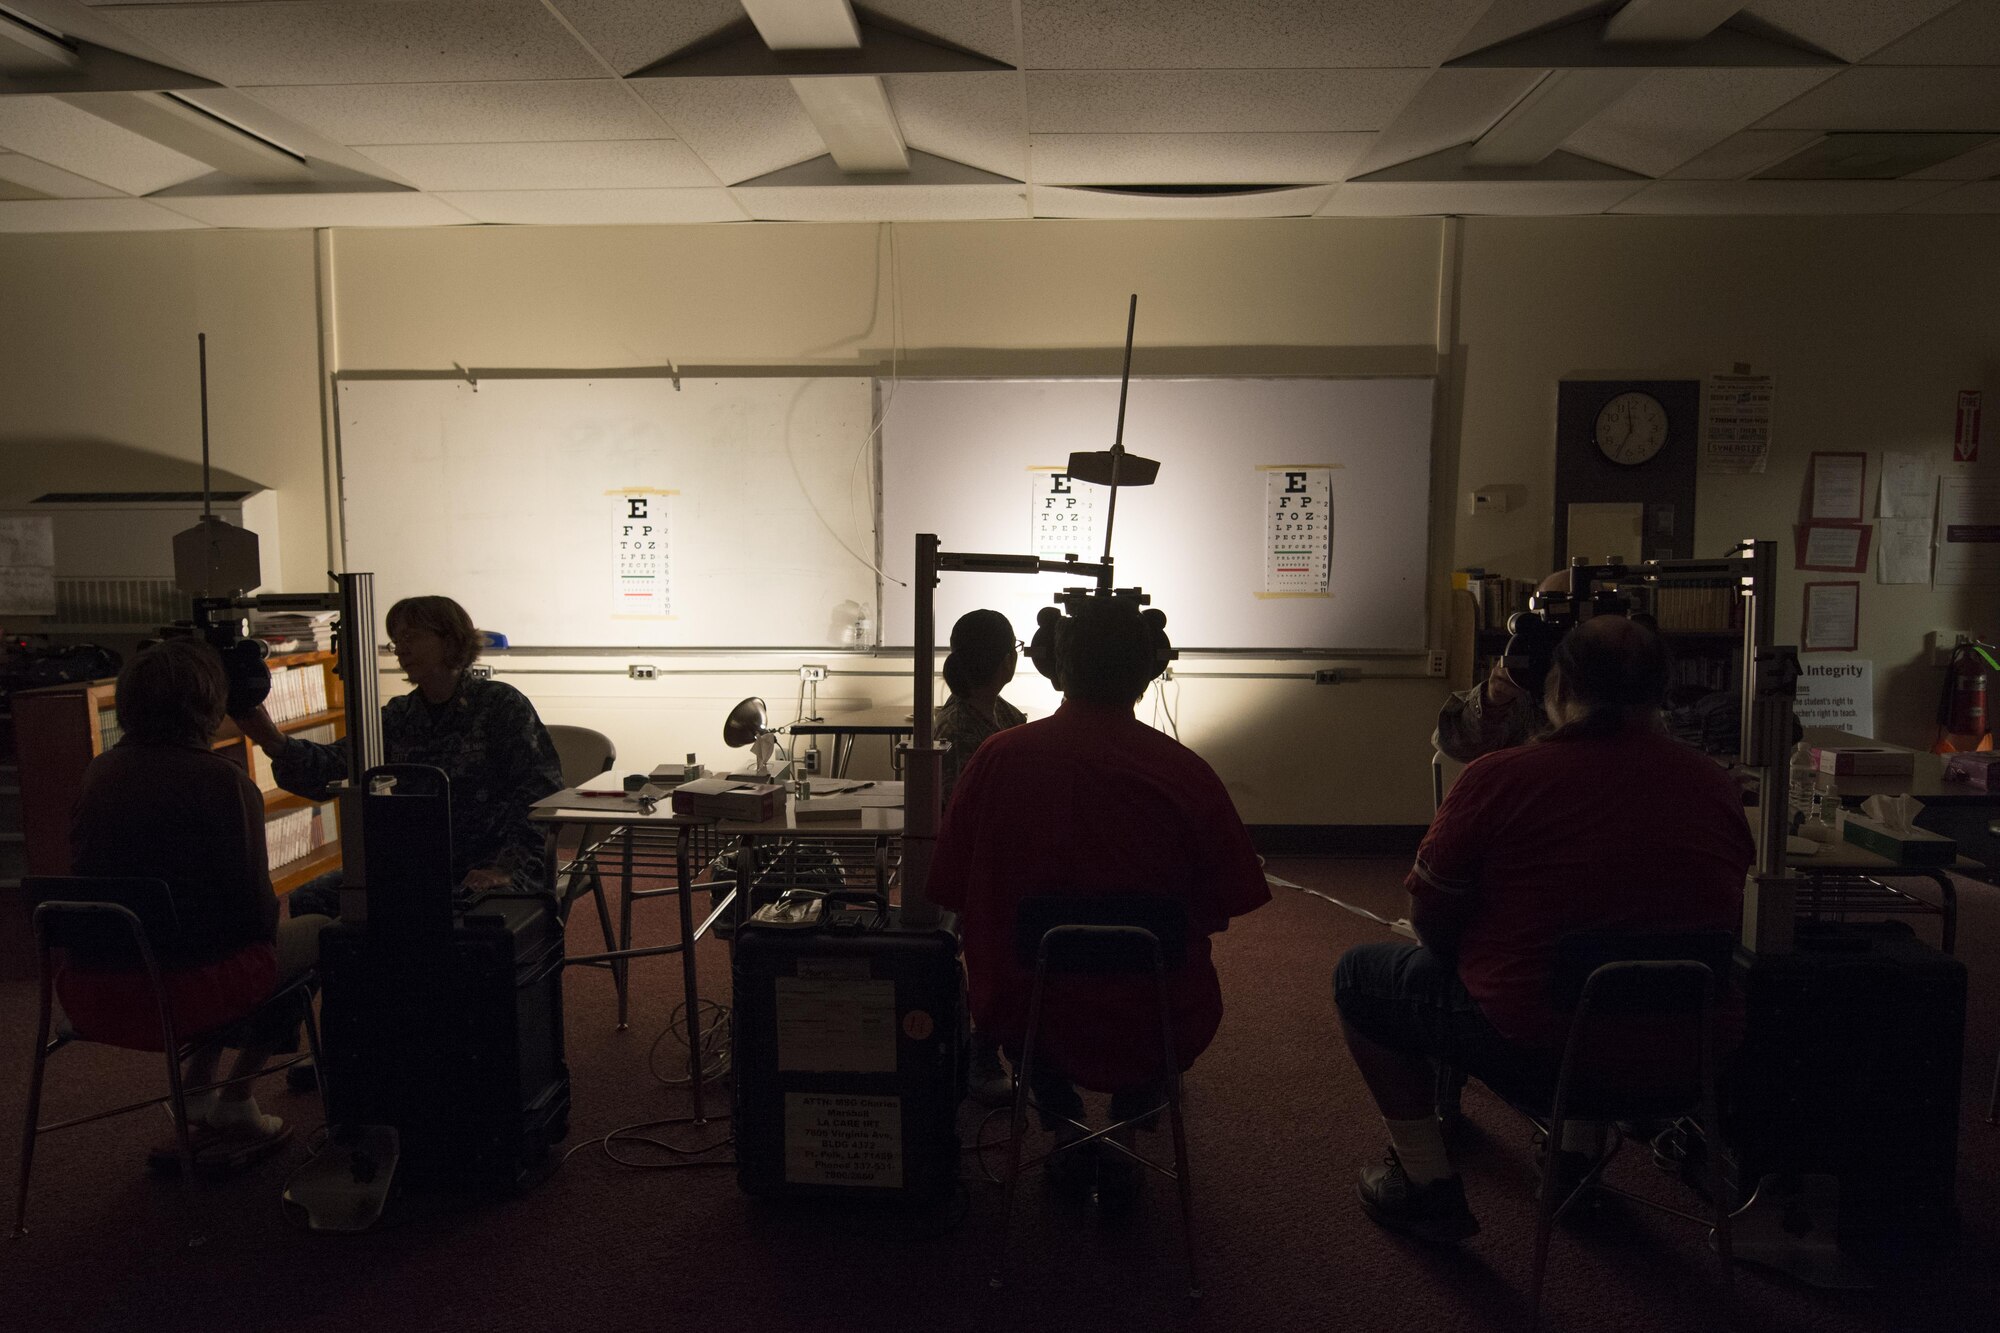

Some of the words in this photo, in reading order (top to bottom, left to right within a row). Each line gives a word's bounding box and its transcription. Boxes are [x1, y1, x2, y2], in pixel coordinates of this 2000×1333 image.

[1051, 474, 1071, 493] E
[1285, 472, 1307, 493] E
[1046, 498, 1056, 508] F
[1066, 498, 1076, 508] P
[1280, 497, 1291, 508] F
[1301, 497, 1312, 508] P
[628, 499, 647, 518] E
[1042, 513, 1049, 521] T
[1056, 513, 1064, 521] O
[1291, 512, 1299, 520] O
[1306, 512, 1313, 520] Z
[623, 526, 633, 536] F
[643, 526, 652, 536] P
[634, 541, 642, 549] O
[1807, 665, 1863, 678] Integrity
[1832, 698, 1845, 707] right
[1847, 697, 1853, 705] to
[1817, 710, 1831, 719] right
[833, 1119, 860, 1127] CARE
[831, 1130, 869, 1139] Virginia
